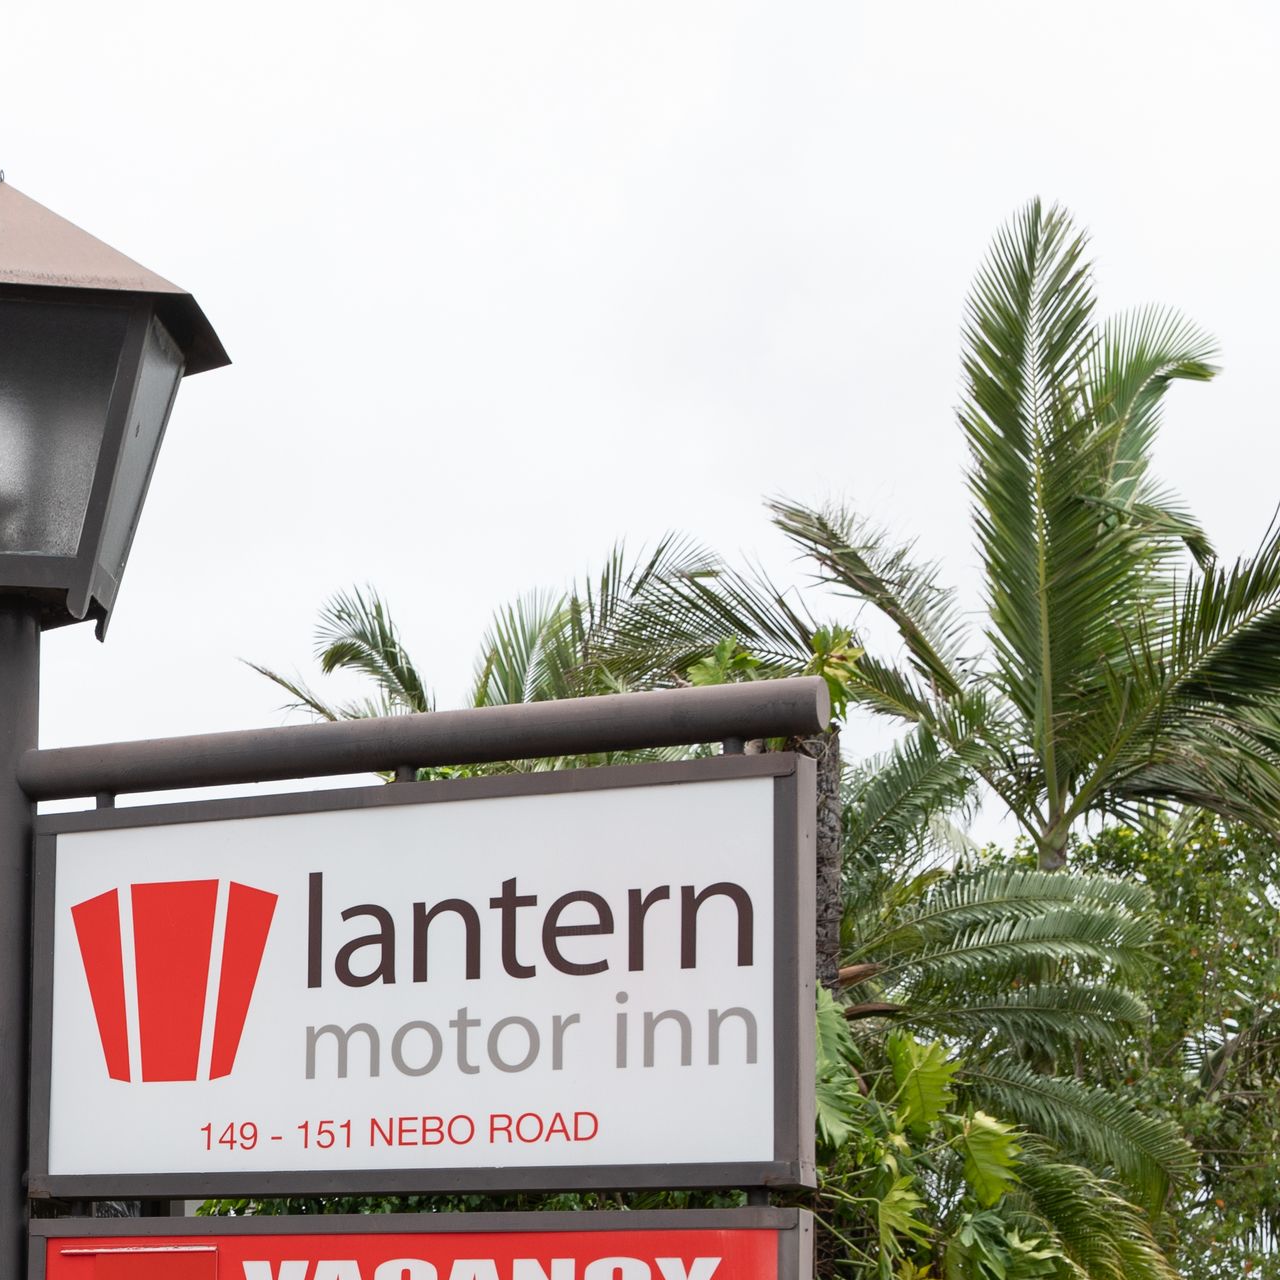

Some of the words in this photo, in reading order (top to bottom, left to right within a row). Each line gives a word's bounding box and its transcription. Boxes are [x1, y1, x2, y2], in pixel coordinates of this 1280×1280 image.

[307, 871, 754, 988] lantern
[305, 1006, 581, 1079] motor
[615, 991, 758, 1069] inn
[200, 1120, 259, 1151] 149
[297, 1119, 352, 1149] 151
[369, 1114, 476, 1147] NEBO
[489, 1111, 599, 1144] ROAD
